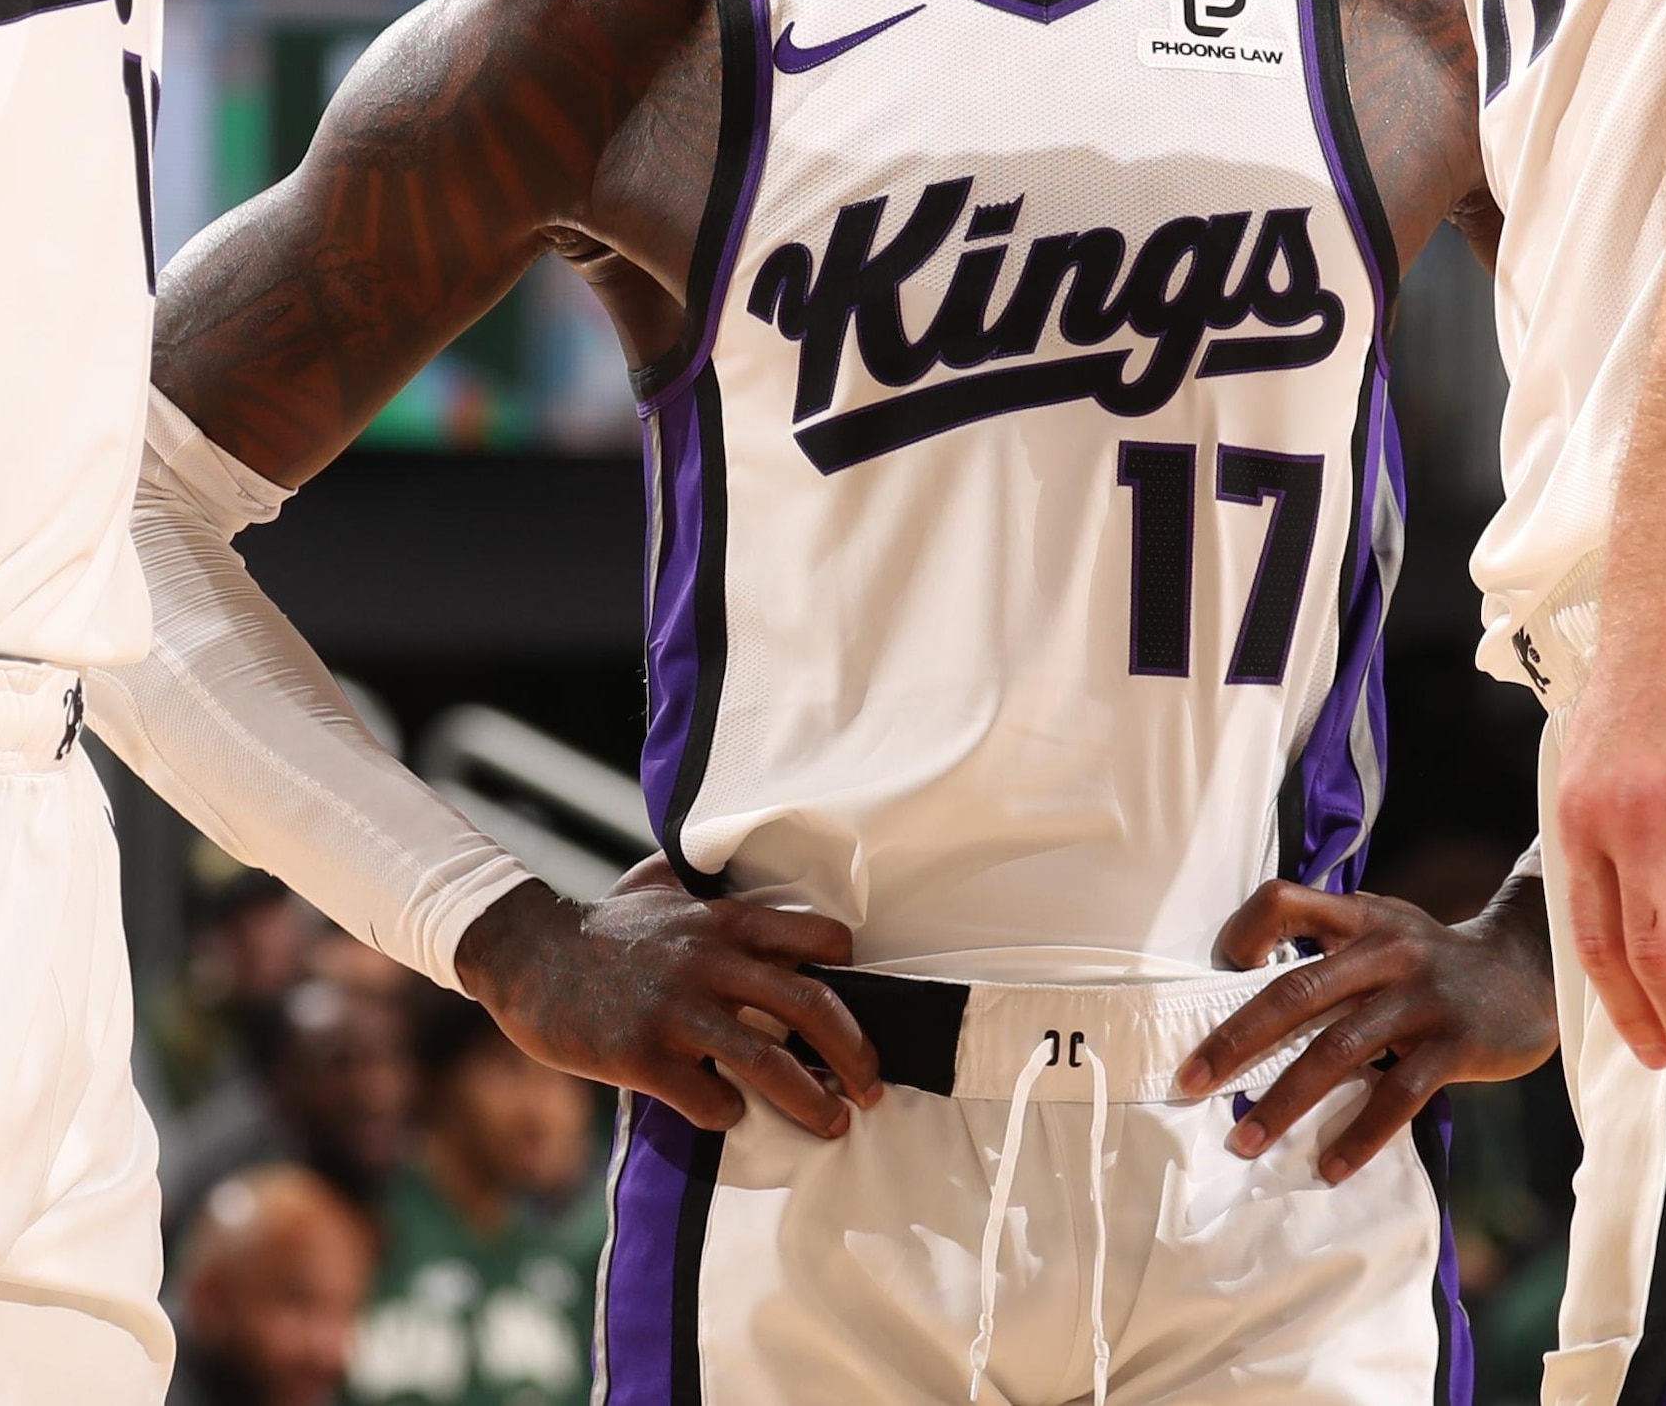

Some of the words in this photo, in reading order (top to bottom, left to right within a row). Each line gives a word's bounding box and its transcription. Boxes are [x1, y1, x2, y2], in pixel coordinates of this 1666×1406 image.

[121, 48, 161, 297] 1
[1151, 40, 1236, 60] PHOONG
[1240, 47, 1283, 65] LAW
[745, 177, 1345, 436] Kings
[1117, 439, 1325, 686] 17
